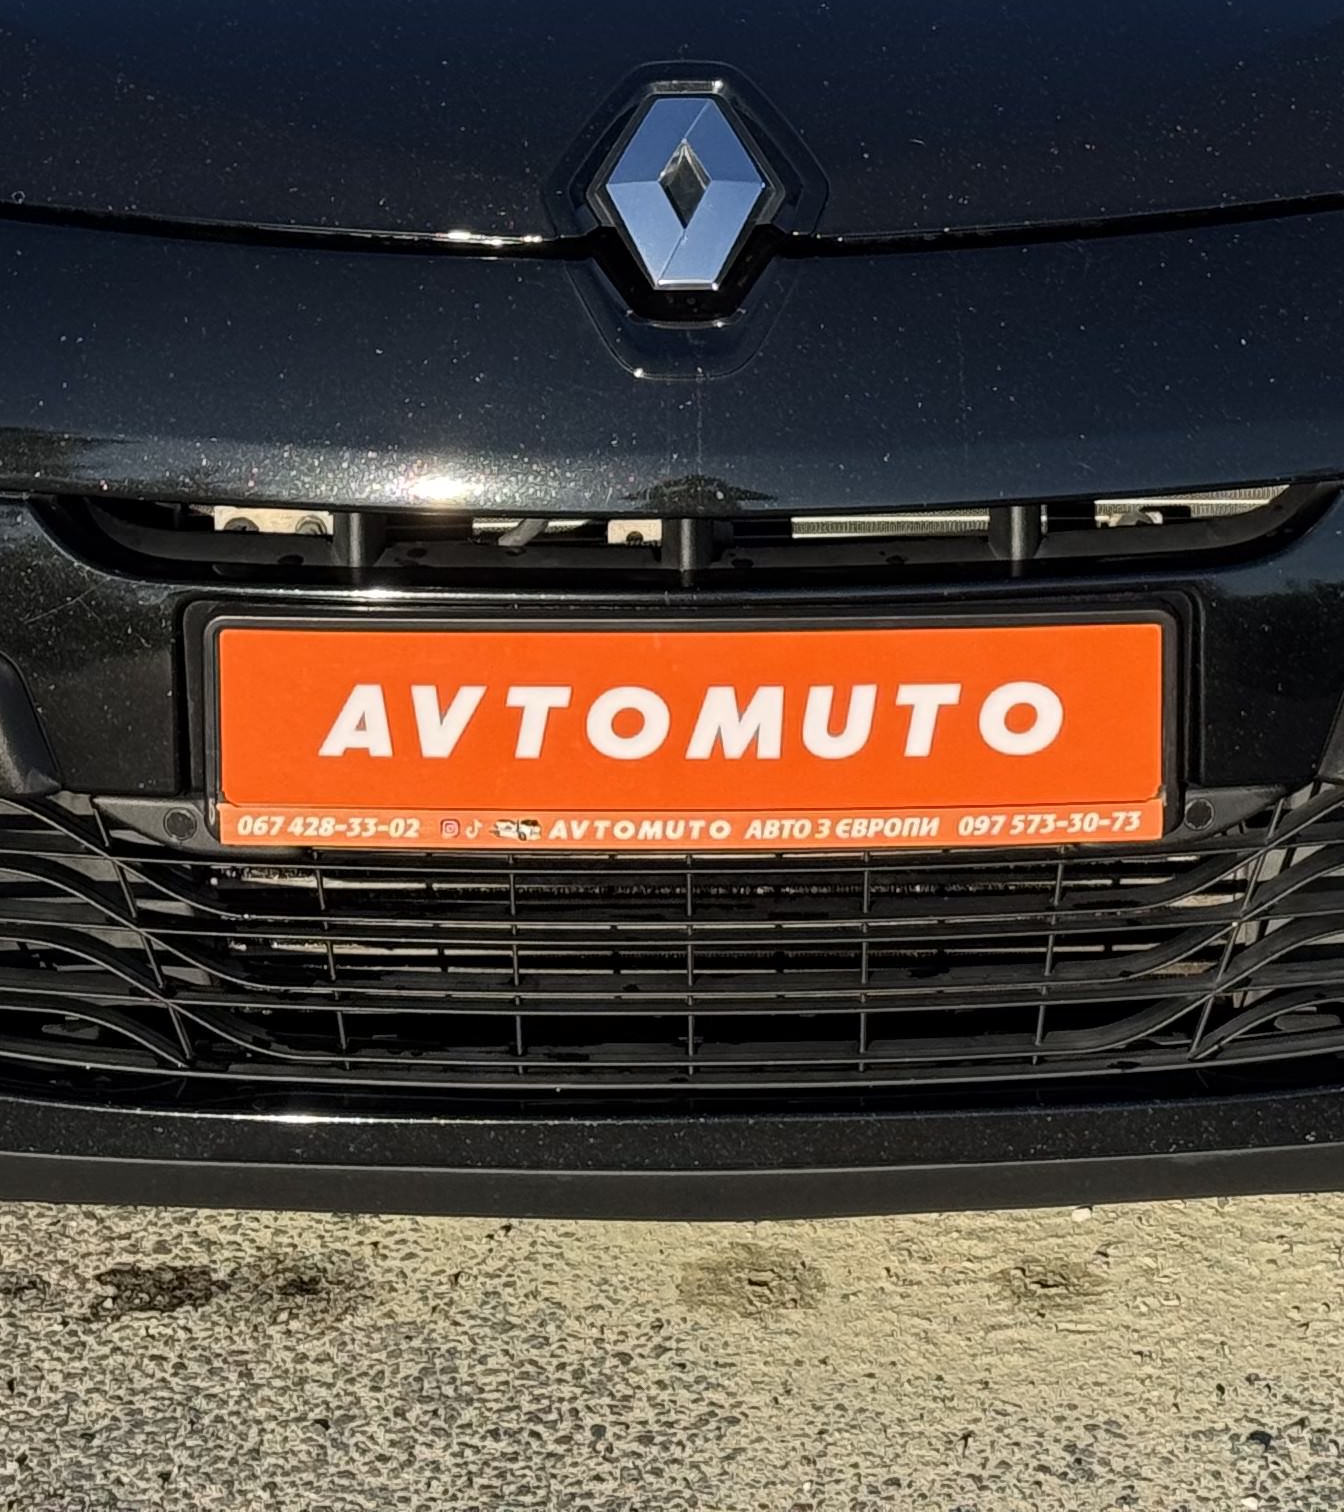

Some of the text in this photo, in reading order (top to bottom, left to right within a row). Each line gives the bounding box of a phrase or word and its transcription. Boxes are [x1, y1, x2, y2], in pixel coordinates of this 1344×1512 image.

[318, 681, 1064, 760] AVTOMUTO
[237, 815, 285, 836] 067
[287, 816, 421, 838] 428-33-02
[548, 819, 732, 840] AVTOMUTO
[744, 818, 812, 840] АВТО
[835, 816, 941, 839] ЄВРОПИ
[958, 815, 1006, 836] 097
[1008, 810, 1142, 835] 573-30-73
